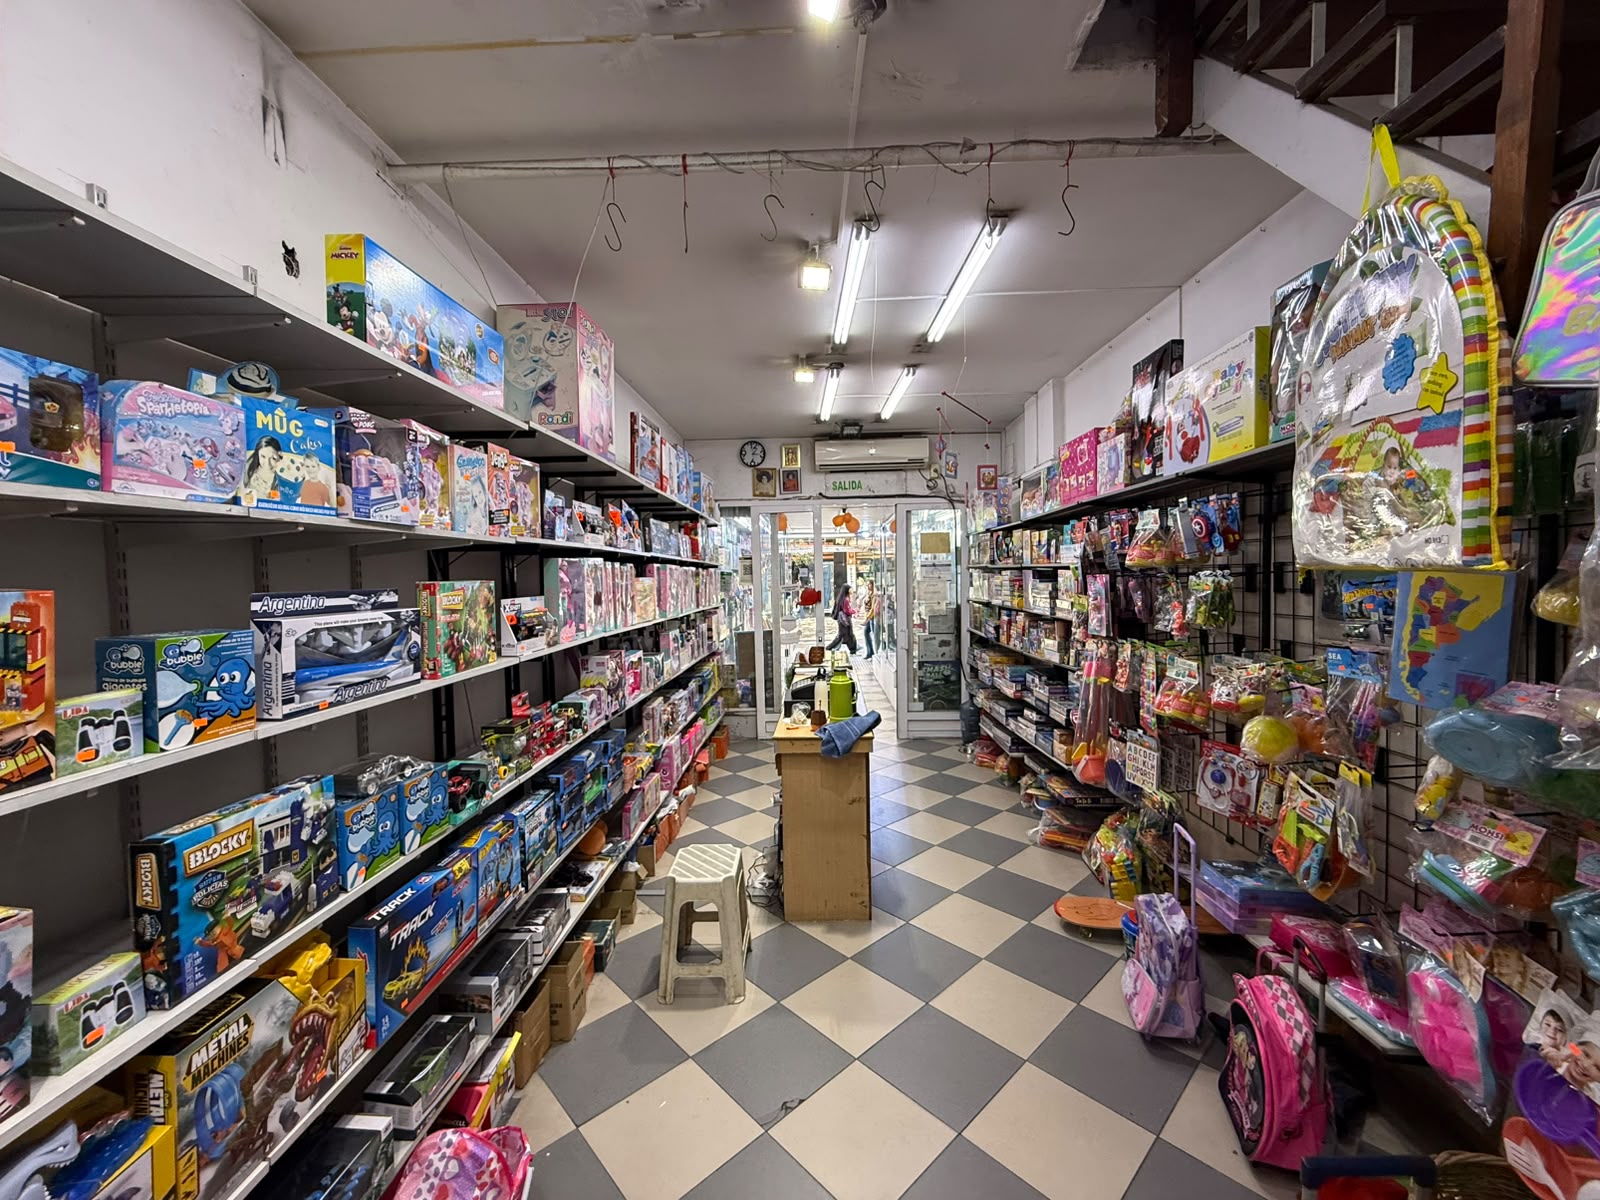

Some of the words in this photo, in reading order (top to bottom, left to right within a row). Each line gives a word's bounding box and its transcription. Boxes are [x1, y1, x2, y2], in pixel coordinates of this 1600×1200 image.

[538, 411, 574, 425] Rondi
[193, 468, 207, 479] 32
[832, 480, 863, 491] SALIDA
[258, 593, 326, 615] Argentina
[110, 660, 142, 669] bubble
[166, 653, 203, 666] bubble
[1327, 652, 1342, 660] SEA
[262, 660, 273, 717] Argentina
[334, 677, 389, 704] Argentina
[62, 706, 90, 720] LIDA
[1469, 823, 1505, 841] MONSI
[188, 829, 249, 869] BLOCKY
[140, 859, 153, 904] BLOCKY
[192, 879, 229, 905] POLICIAS
[367, 887, 417, 921] TRACK
[390, 900, 436, 951] TRACK
[190, 1016, 249, 1073] METAL
[190, 1030, 250, 1091] MACHINES
